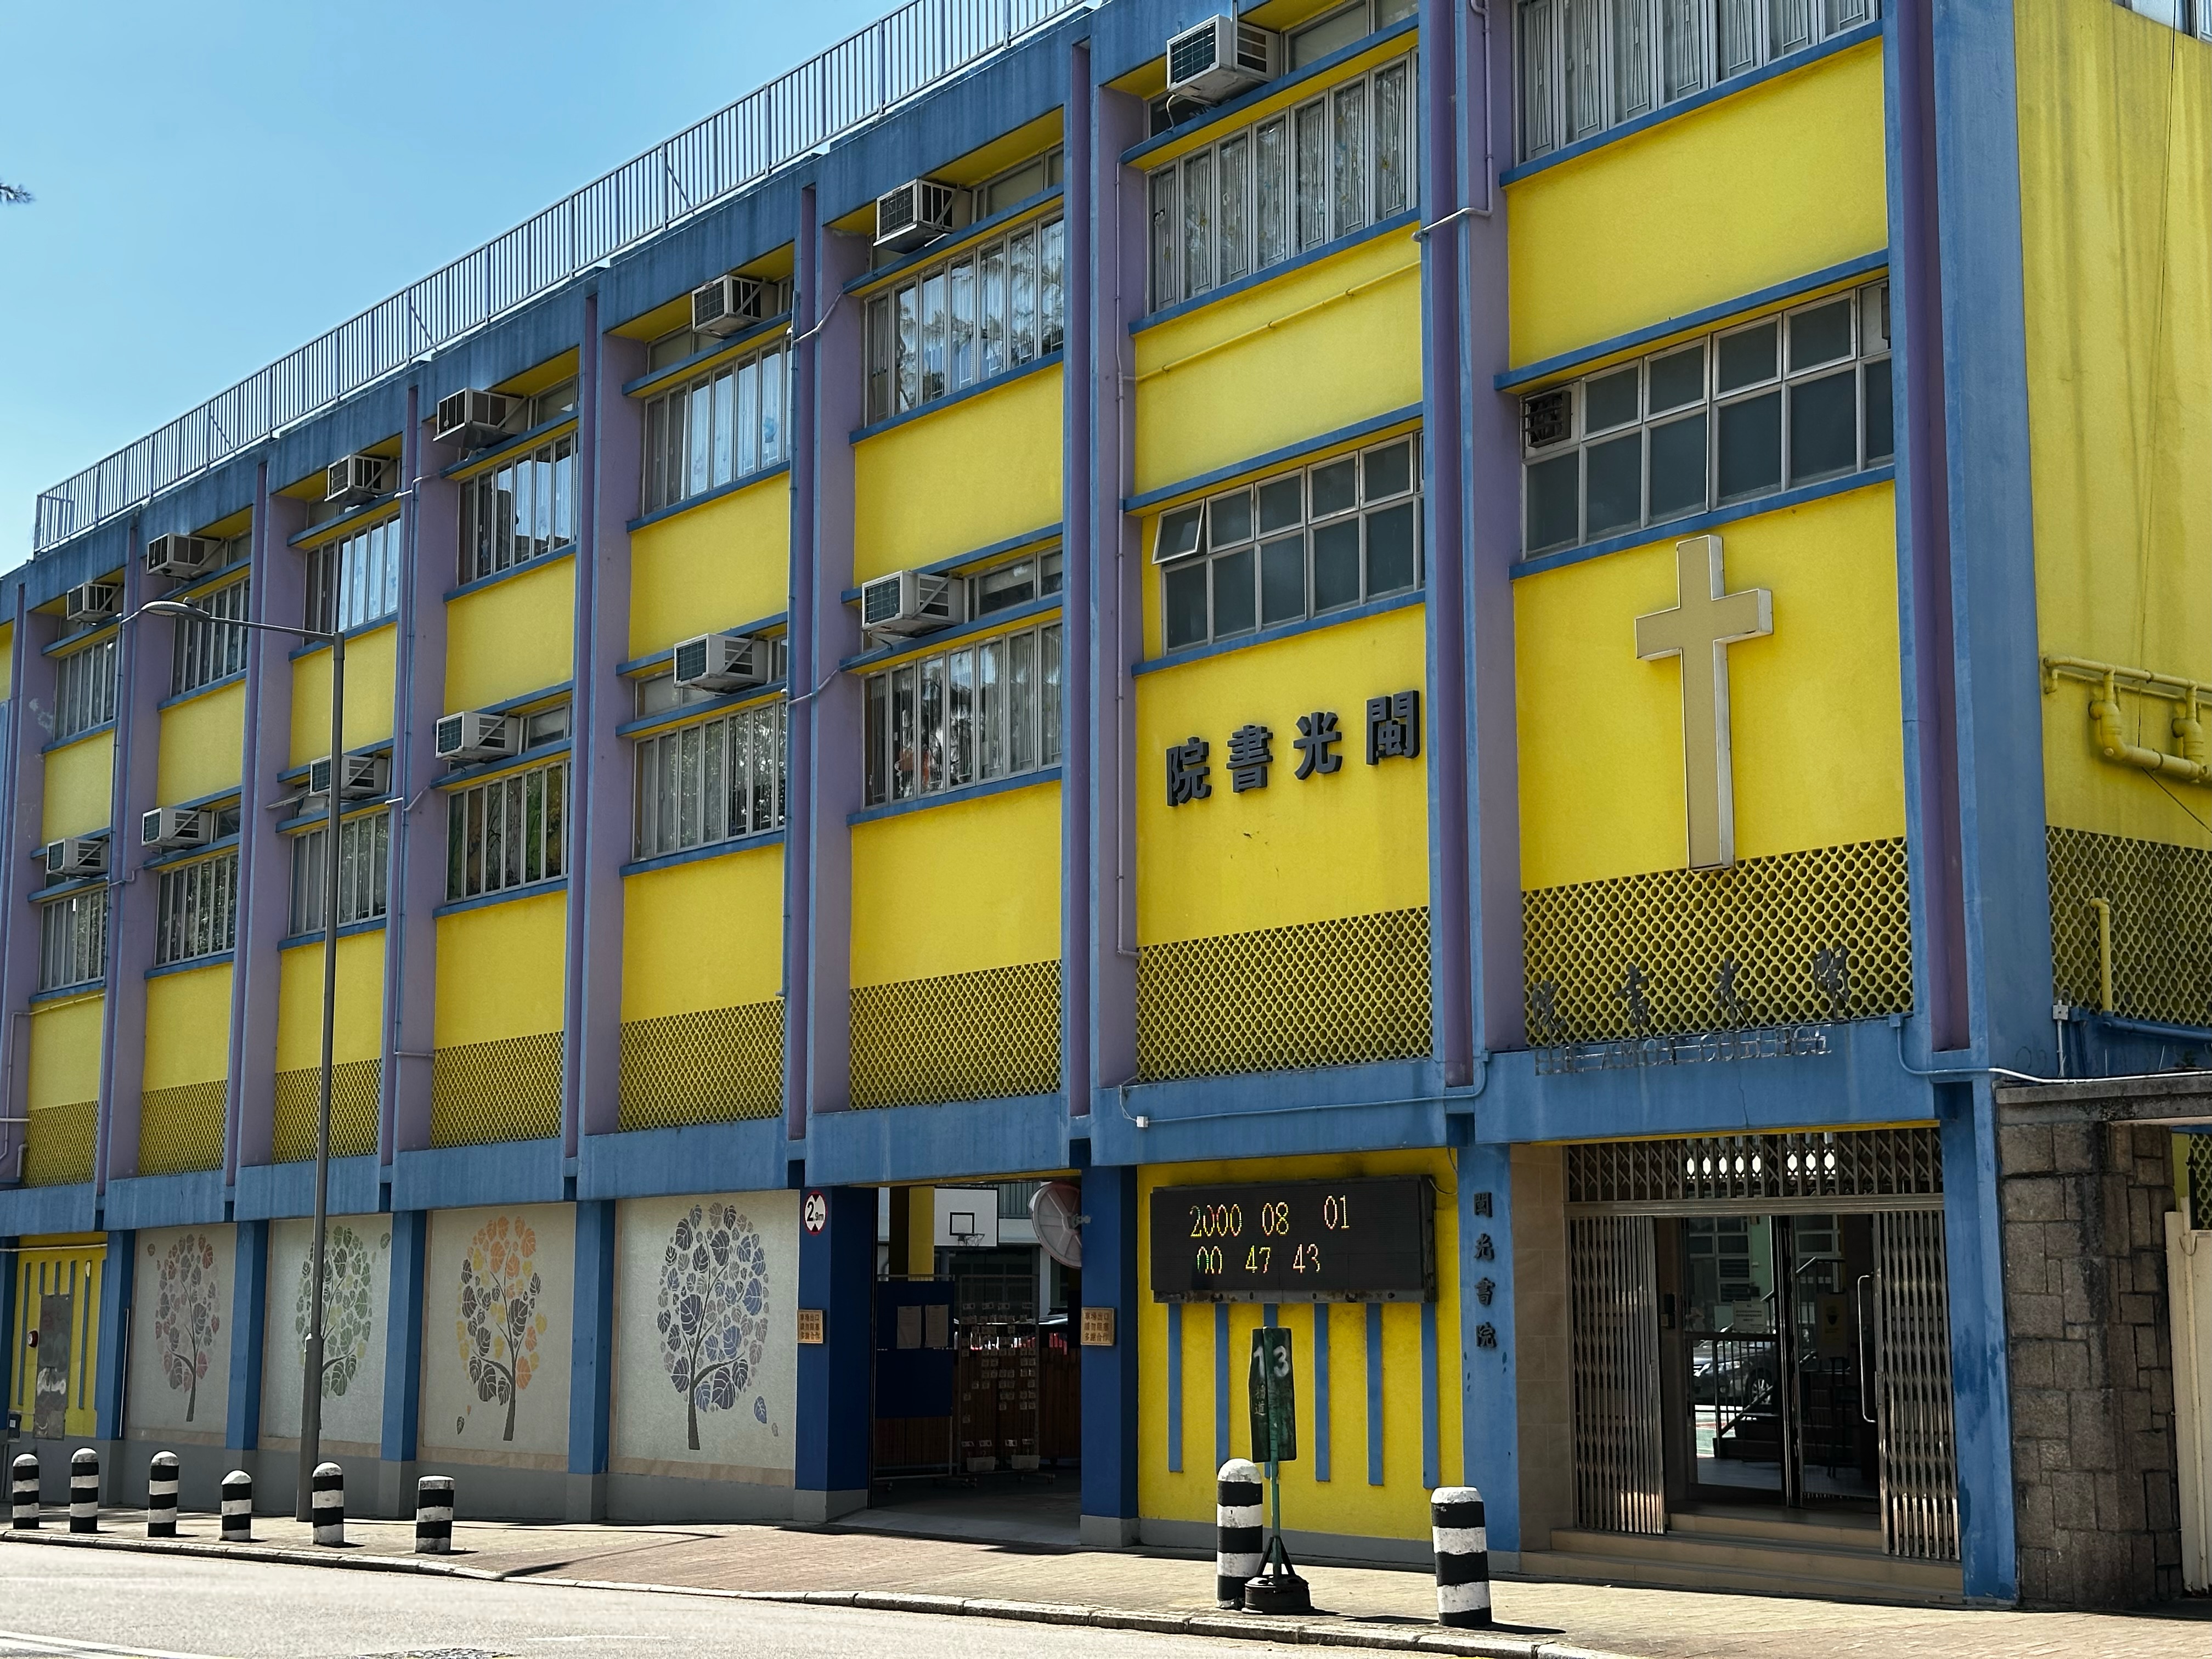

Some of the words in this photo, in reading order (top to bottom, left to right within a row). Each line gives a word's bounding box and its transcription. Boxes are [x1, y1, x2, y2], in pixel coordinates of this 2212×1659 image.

[1166, 690, 1420, 806] 閩光書院
[1189, 1204, 1242, 1238] 2000
[1262, 1201, 1289, 1236] 08
[1324, 1195, 1350, 1229] 01
[1245, 1245, 1271, 1273] 47
[1293, 1244, 1321, 1273] 43
[1474, 1192, 1497, 1348] 閩光書院
[1254, 1345, 1289, 1377] 13
